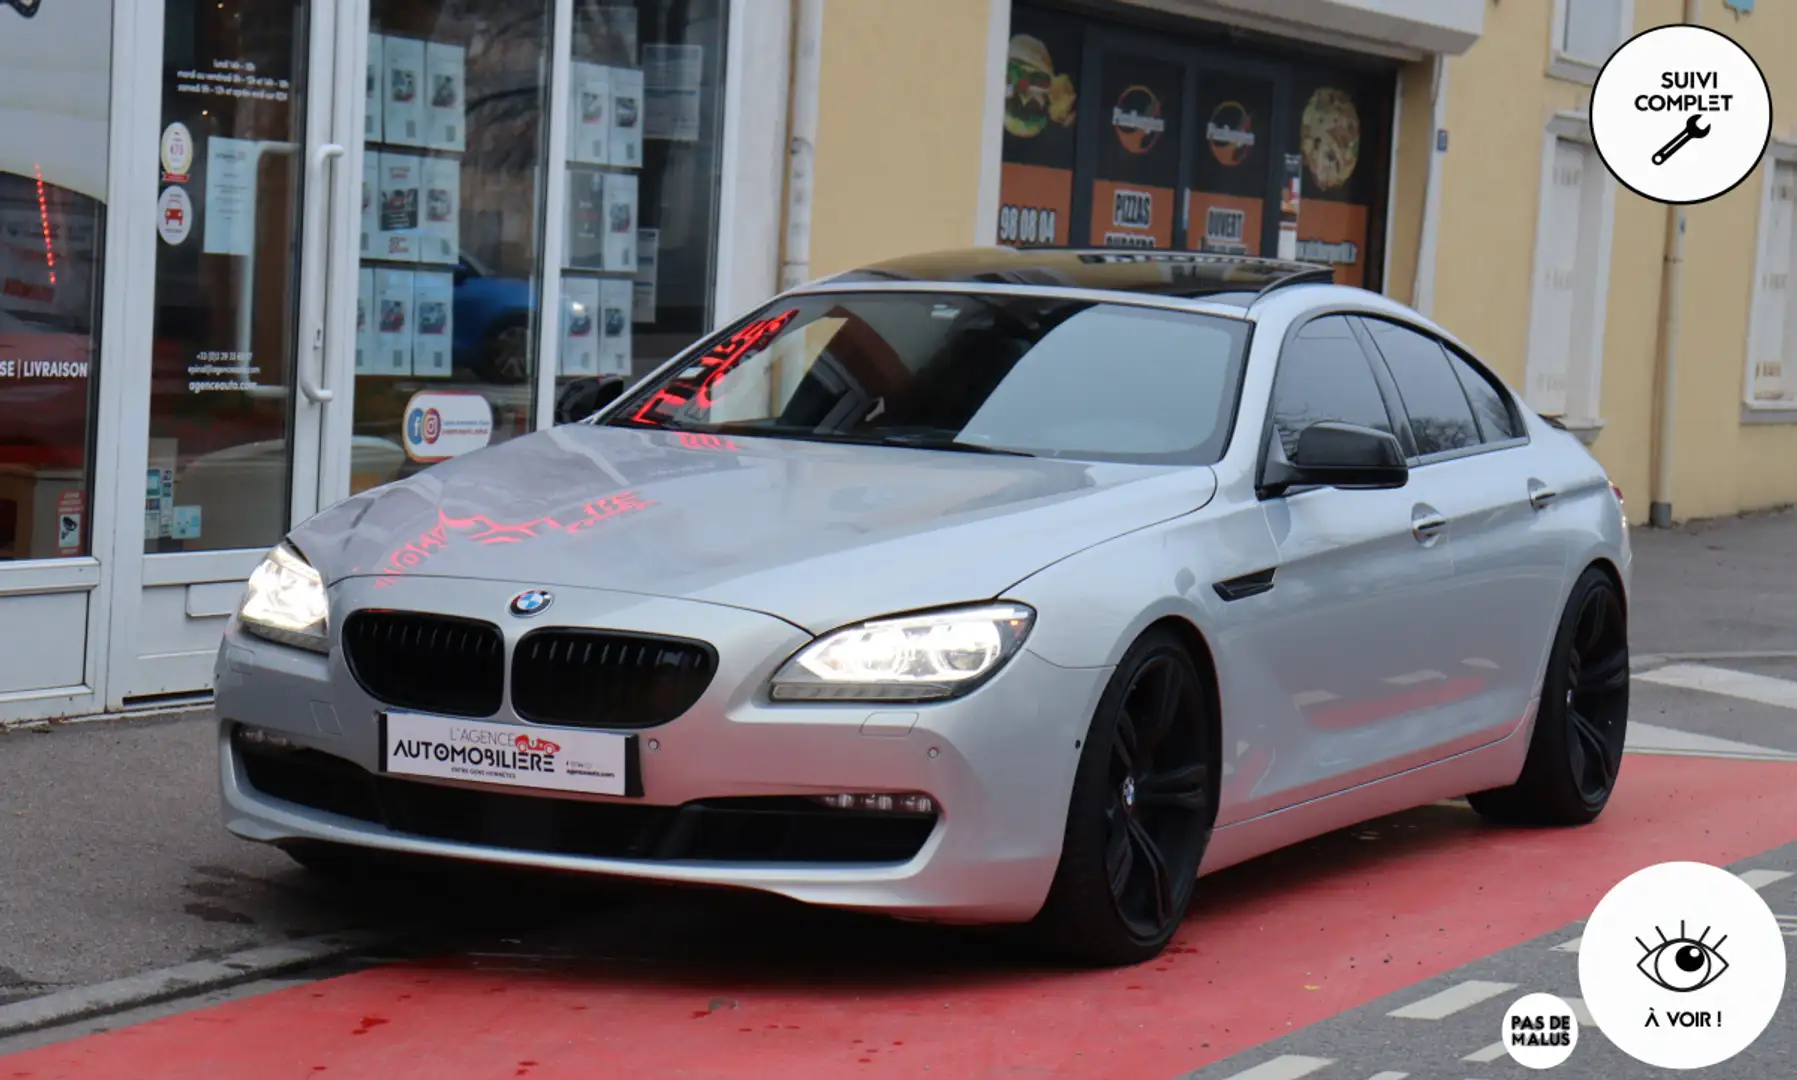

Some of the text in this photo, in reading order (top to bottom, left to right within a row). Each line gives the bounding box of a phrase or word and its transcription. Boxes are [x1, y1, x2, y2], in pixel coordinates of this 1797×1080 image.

[1000, 205, 1018, 240] 98
[1115, 191, 1150, 227] PIZZAS
[1208, 209, 1243, 239] OUVERT
[23, 361, 88, 378] LIVRAISON
[449, 727, 515, 747] L'AGENCE
